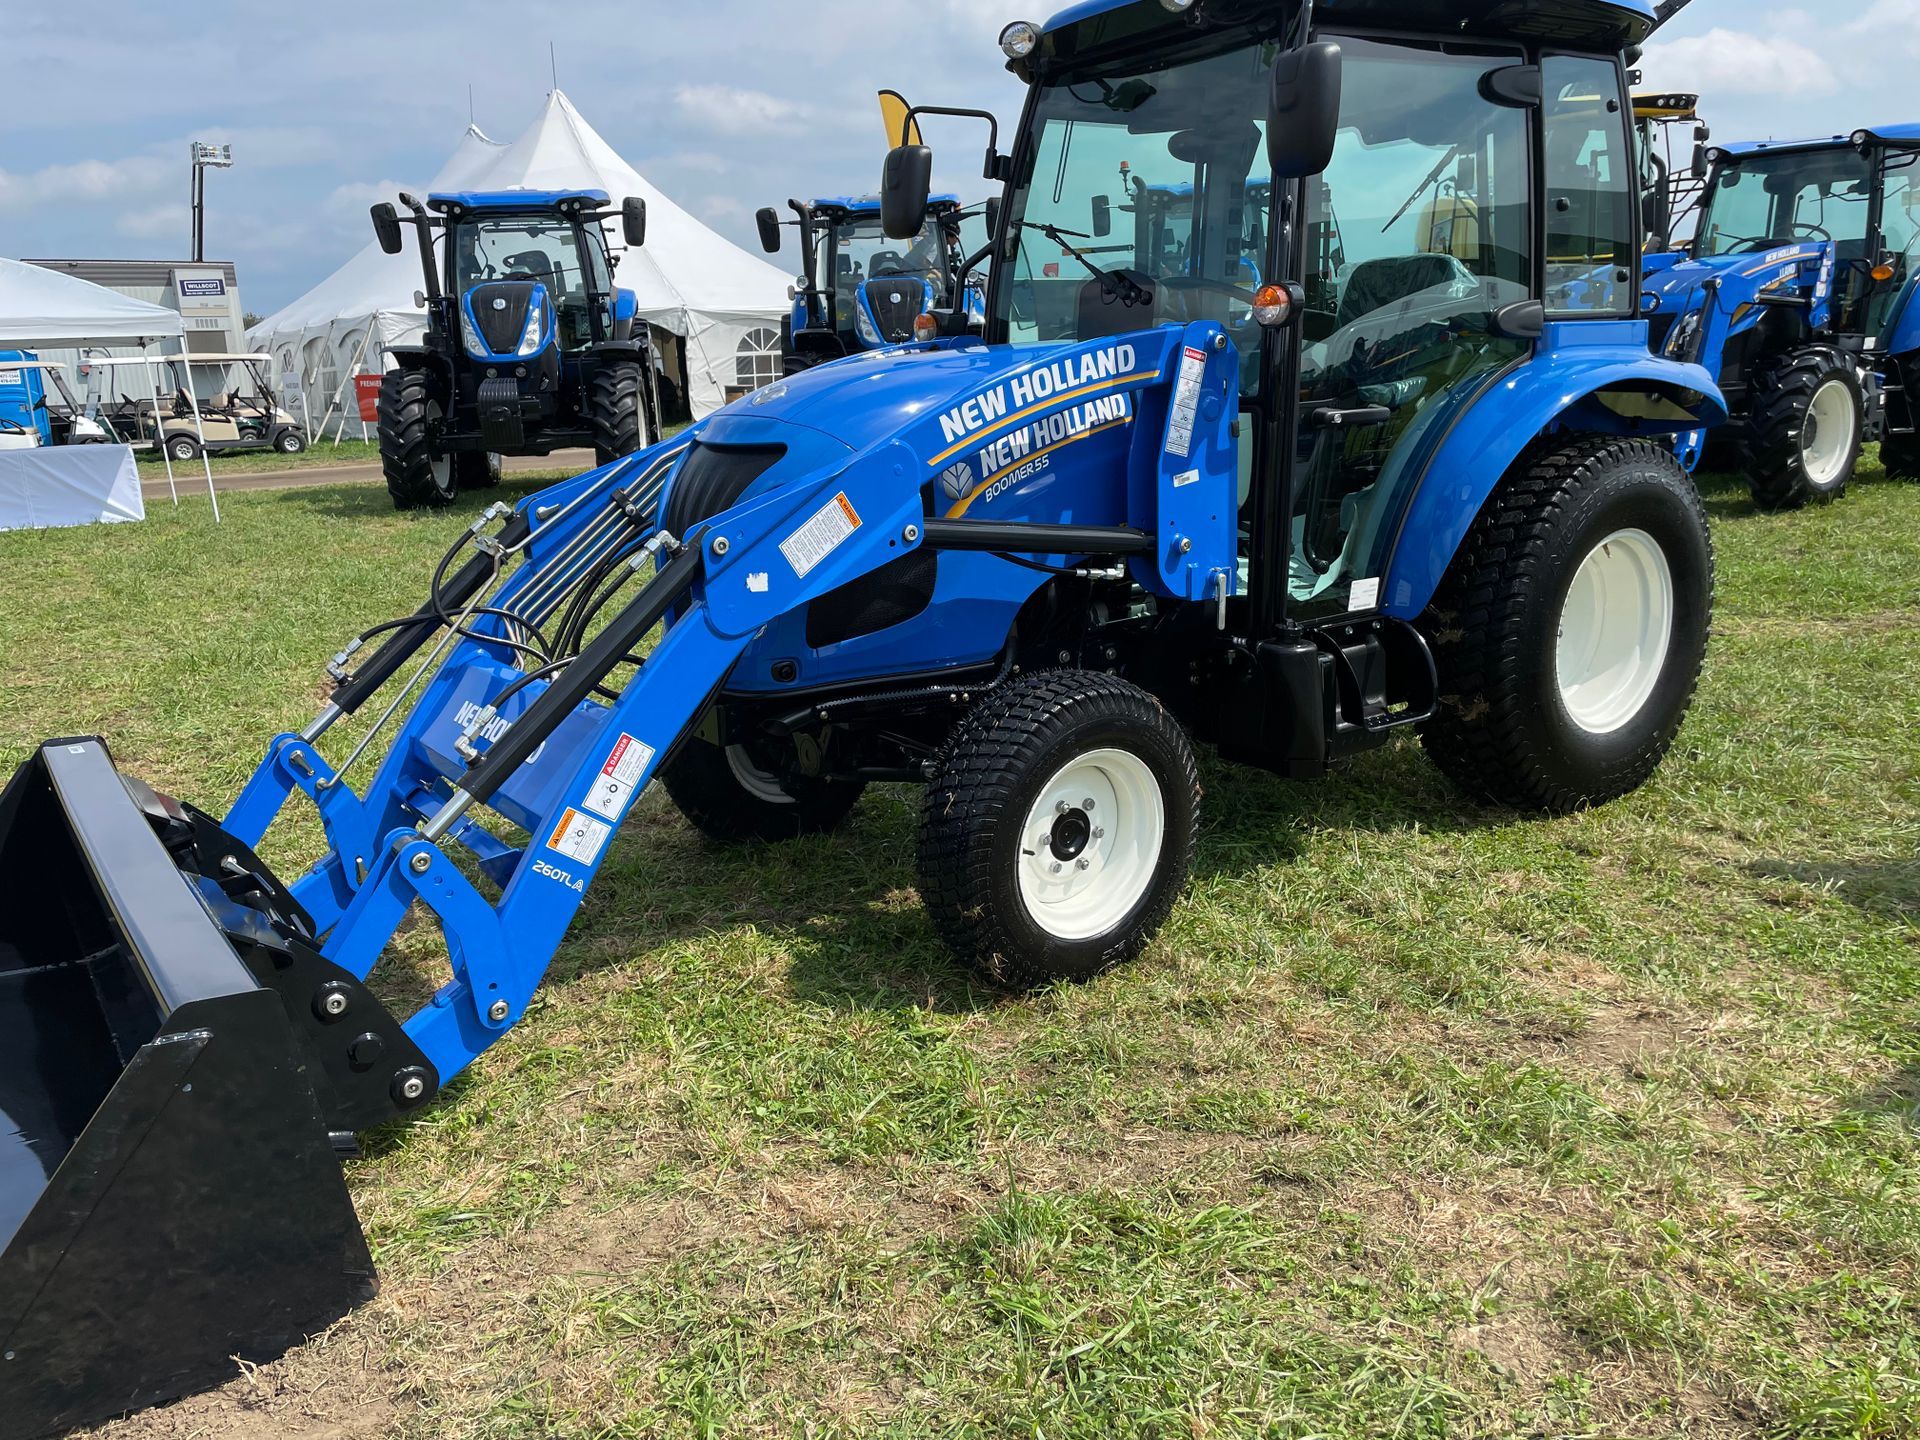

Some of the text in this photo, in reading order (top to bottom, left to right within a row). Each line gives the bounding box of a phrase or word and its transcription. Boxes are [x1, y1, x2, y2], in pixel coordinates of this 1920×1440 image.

[938, 344, 1136, 443] NEW HOLLAND
[979, 393, 1127, 478] NEW HOLLAND
[985, 454, 1050, 503] BOOMER 55
[609, 738, 629, 766] DANGER
[557, 813, 573, 840] WARNING
